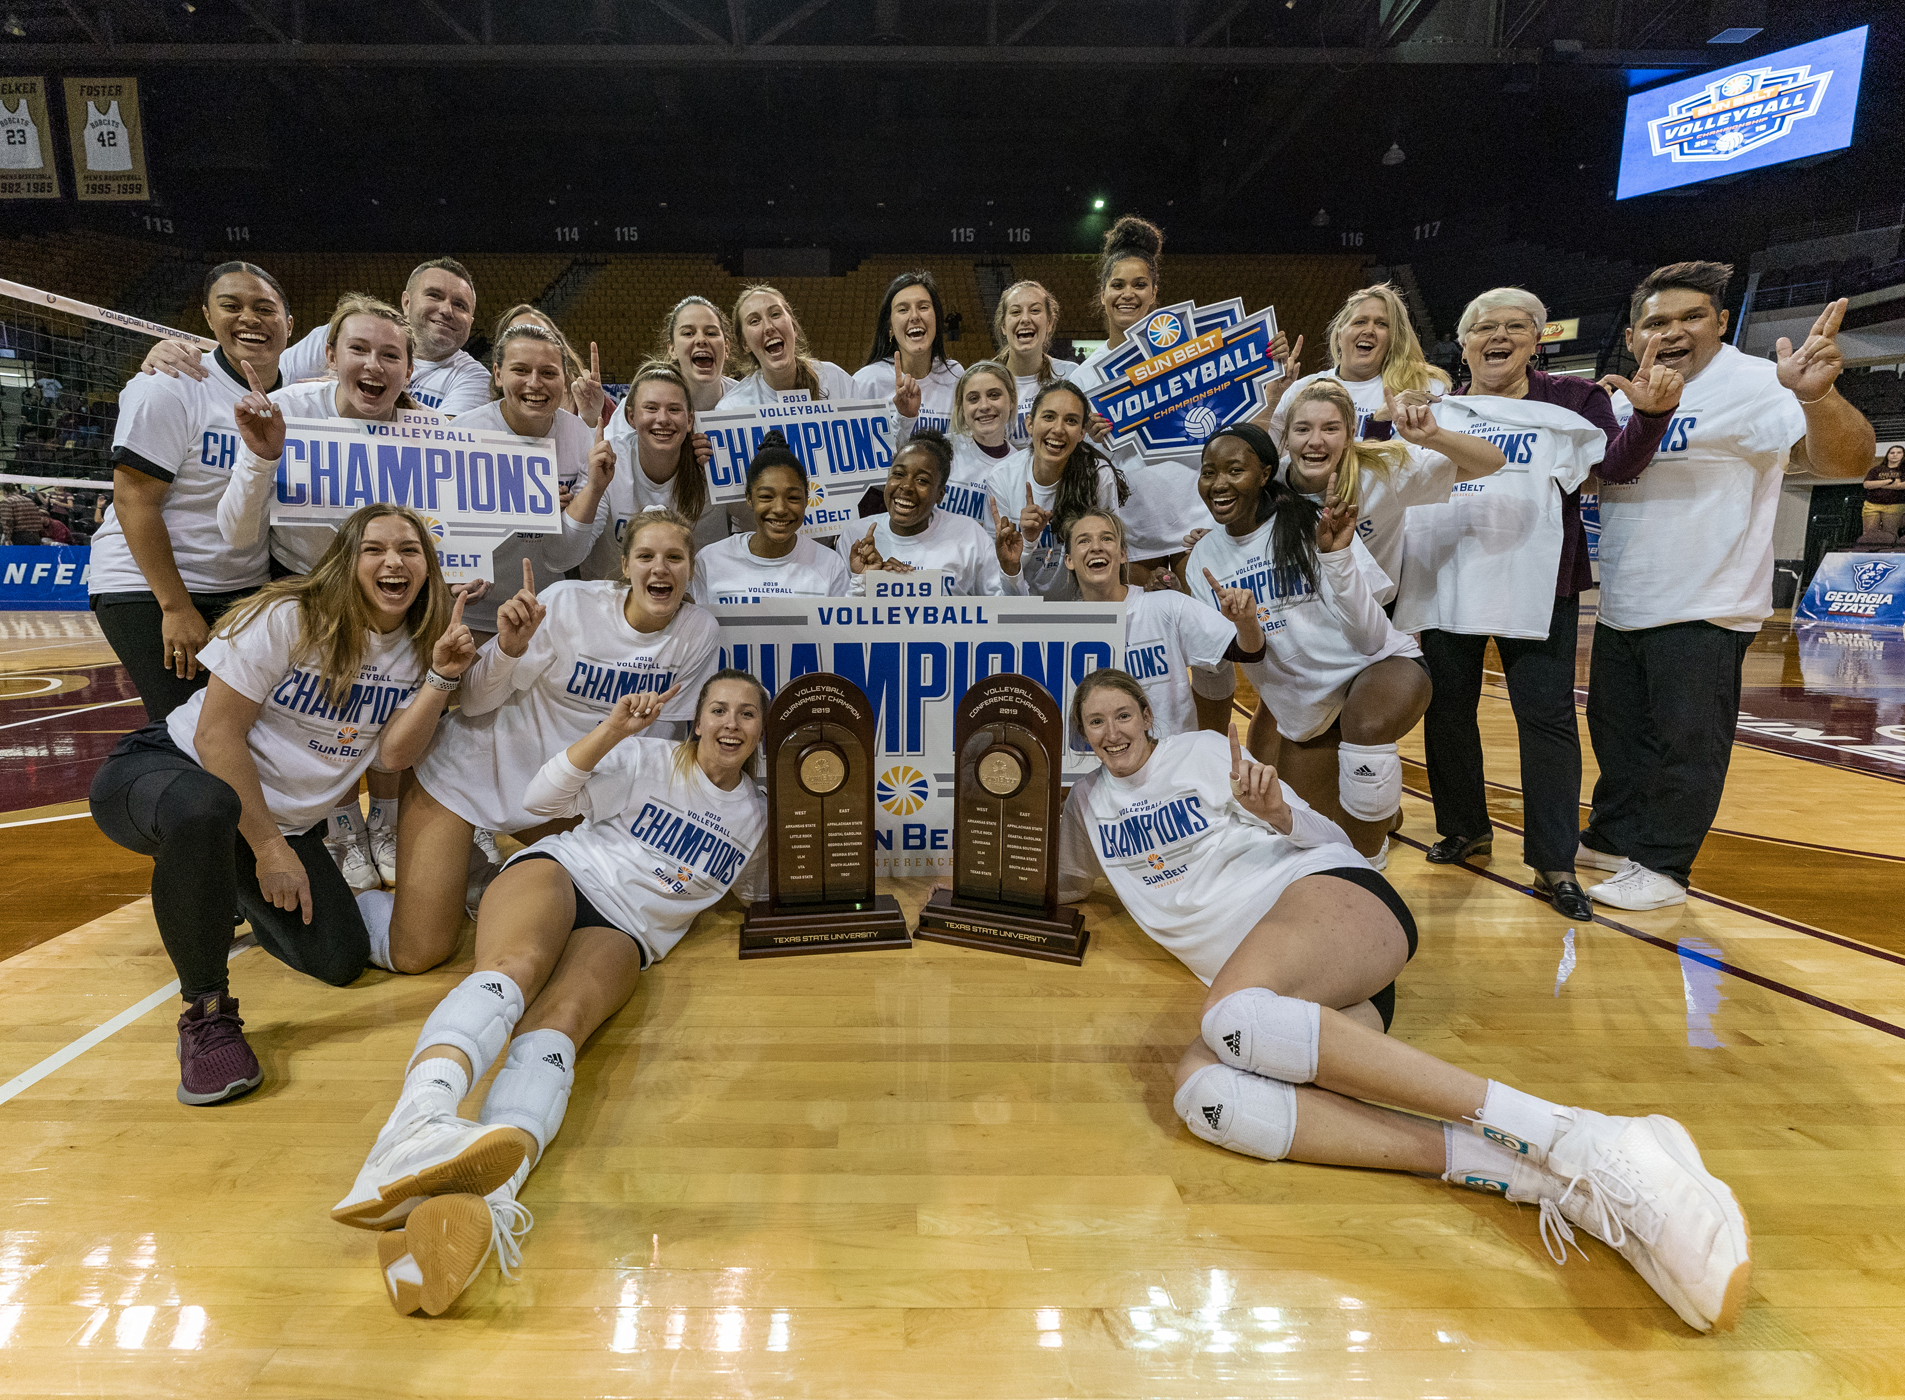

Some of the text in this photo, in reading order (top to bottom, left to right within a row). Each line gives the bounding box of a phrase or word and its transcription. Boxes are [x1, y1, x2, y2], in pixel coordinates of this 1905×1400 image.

[0, 82, 37, 95] ELKER
[79, 85, 122, 96] FOSTER
[1697, 88, 1776, 116] SUN BELT
[89, 118, 121, 129] BOBCATS
[1665, 93, 1806, 141] VOLLEYBALL
[1696, 117, 1769, 139] CHAMPIONSHIP
[6, 129, 27, 145] 23
[97, 131, 118, 147] 42
[0, 182, 53, 194] 982-1985
[85, 183, 142, 195] 1995-1999
[143, 216, 174, 234] 113
[1414, 221, 1441, 240] 117
[226, 226, 250, 241] 114
[555, 227, 579, 241] 114
[614, 227, 638, 241] 115
[951, 227, 975, 242] 115
[1007, 227, 1031, 242] 116
[1341, 232, 1364, 247] 116
[98, 308, 144, 327] Volleyball
[1134, 334, 1216, 381] SUN BELT
[1107, 342, 1263, 423] VOLLEYBALL
[782, 394, 808, 403] 2019
[1153, 381, 1231, 420] CHAMPIONSHIP
[759, 404, 834, 418] VOLLEYBALL
[403, 414, 440, 426] 2019
[366, 424, 475, 443] VOLLEYBALL
[277, 438, 555, 515] CHAMPIONS
[970, 481, 988, 491] VOLLE
[1459, 482, 1485, 493] BELT
[817, 509, 851, 524] BELT
[799, 525, 843, 535] ONFERENCE
[876, 582, 932, 598] 2019
[1824, 591, 1893, 605] GEORGIA
[818, 606, 988, 626] VOLLEYBALL
[1828, 602, 1879, 615] STATE
[1266, 619, 1287, 632] BELT
[567, 661, 677, 703] CHAMPION
[274, 668, 416, 725] CHAMPIO
[794, 685, 845, 698] VOLLEYBALL
[984, 686, 1033, 700] VOLLEYBALL
[779, 695, 861, 721] TOURNAMENT CHAMPION
[969, 695, 1049, 724] CONFERENCE CHAMPION
[999, 707, 1018, 715] 2019
[308, 739, 366, 757] SUN BE
[1119, 801, 1162, 816] VOLLEYBALL
[1132, 799, 1148, 807] 2019
[687, 810, 731, 837] VOLLEYBALL
[704, 811, 722, 822] 2019
[1098, 796, 1209, 858] CHAMPIONS
[630, 803, 746, 886] CHAMPIONS
[903, 823, 954, 850] BE
[652, 867, 692, 895] SUN BE
[1142, 864, 1188, 885] SUN BELT
[773, 931, 879, 944] TEXAS STATE UNIVERSITY
[944, 921, 1047, 944] TEXAS STATE UNIVERSITY
[480, 984, 505, 1000] adidas
[1234, 1030, 1242, 1057] adidas
[542, 1056, 566, 1073] adidas
